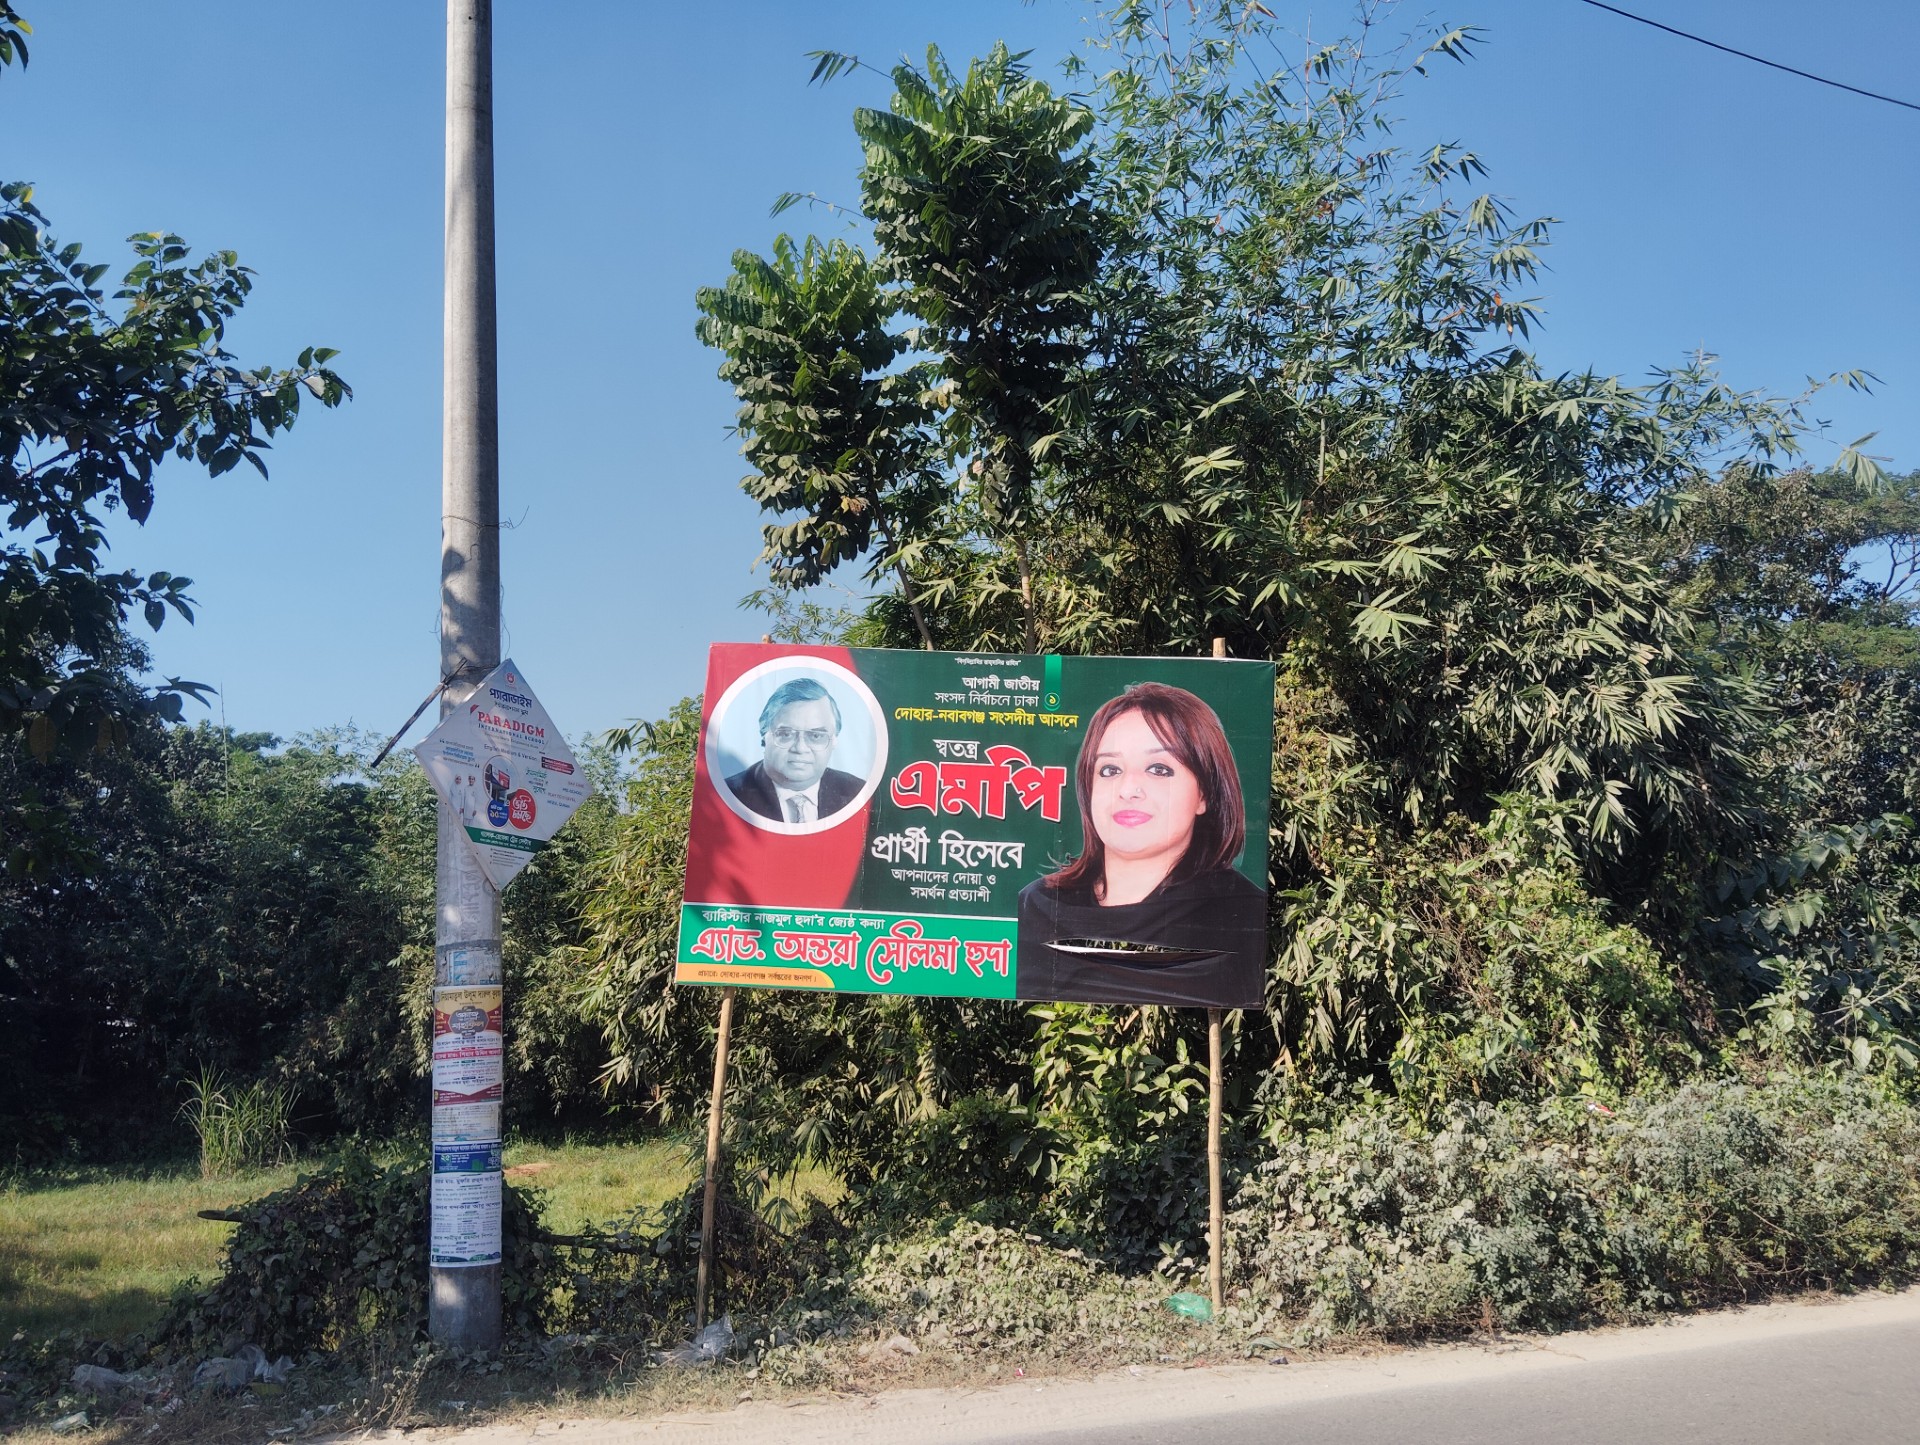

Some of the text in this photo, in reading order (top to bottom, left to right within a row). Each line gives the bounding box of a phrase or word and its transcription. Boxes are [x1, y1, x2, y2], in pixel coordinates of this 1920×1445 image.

[962, 674, 1040, 692] আগামী জাতীয়
[489, 688, 533, 708] প্যারাডাইম
[934, 692, 965, 705] সংসদ
[969, 690, 1011, 707] নির্বাচনে
[1013, 694, 1039, 707] ঢাকা
[478, 711, 545, 738] PARADIGM
[894, 706, 1079, 728] দোহার-নবাবগঞ্জ সংসদীয় আসনে
[933, 738, 980, 760] স্বতন্ত্র
[890, 744, 1067, 823] এমপি
[871, 825, 1025, 869] প্রার্থী হিসেবে
[891, 868, 997, 885] আপনাদের দোয়া ও
[910, 884, 991, 903] সমর্থন প্রত্যাশী
[702, 907, 751, 924] ব্যারিস্টার
[754, 912, 792, 927] নাজমুল
[828, 912, 857, 928] জ্যেষ্ঠ
[859, 918, 885, 930] কন্যা
[772, 930, 862, 970] অন্তরা
[865, 919, 960, 986] সেলিমা
[964, 938, 1013, 978] হুদা
